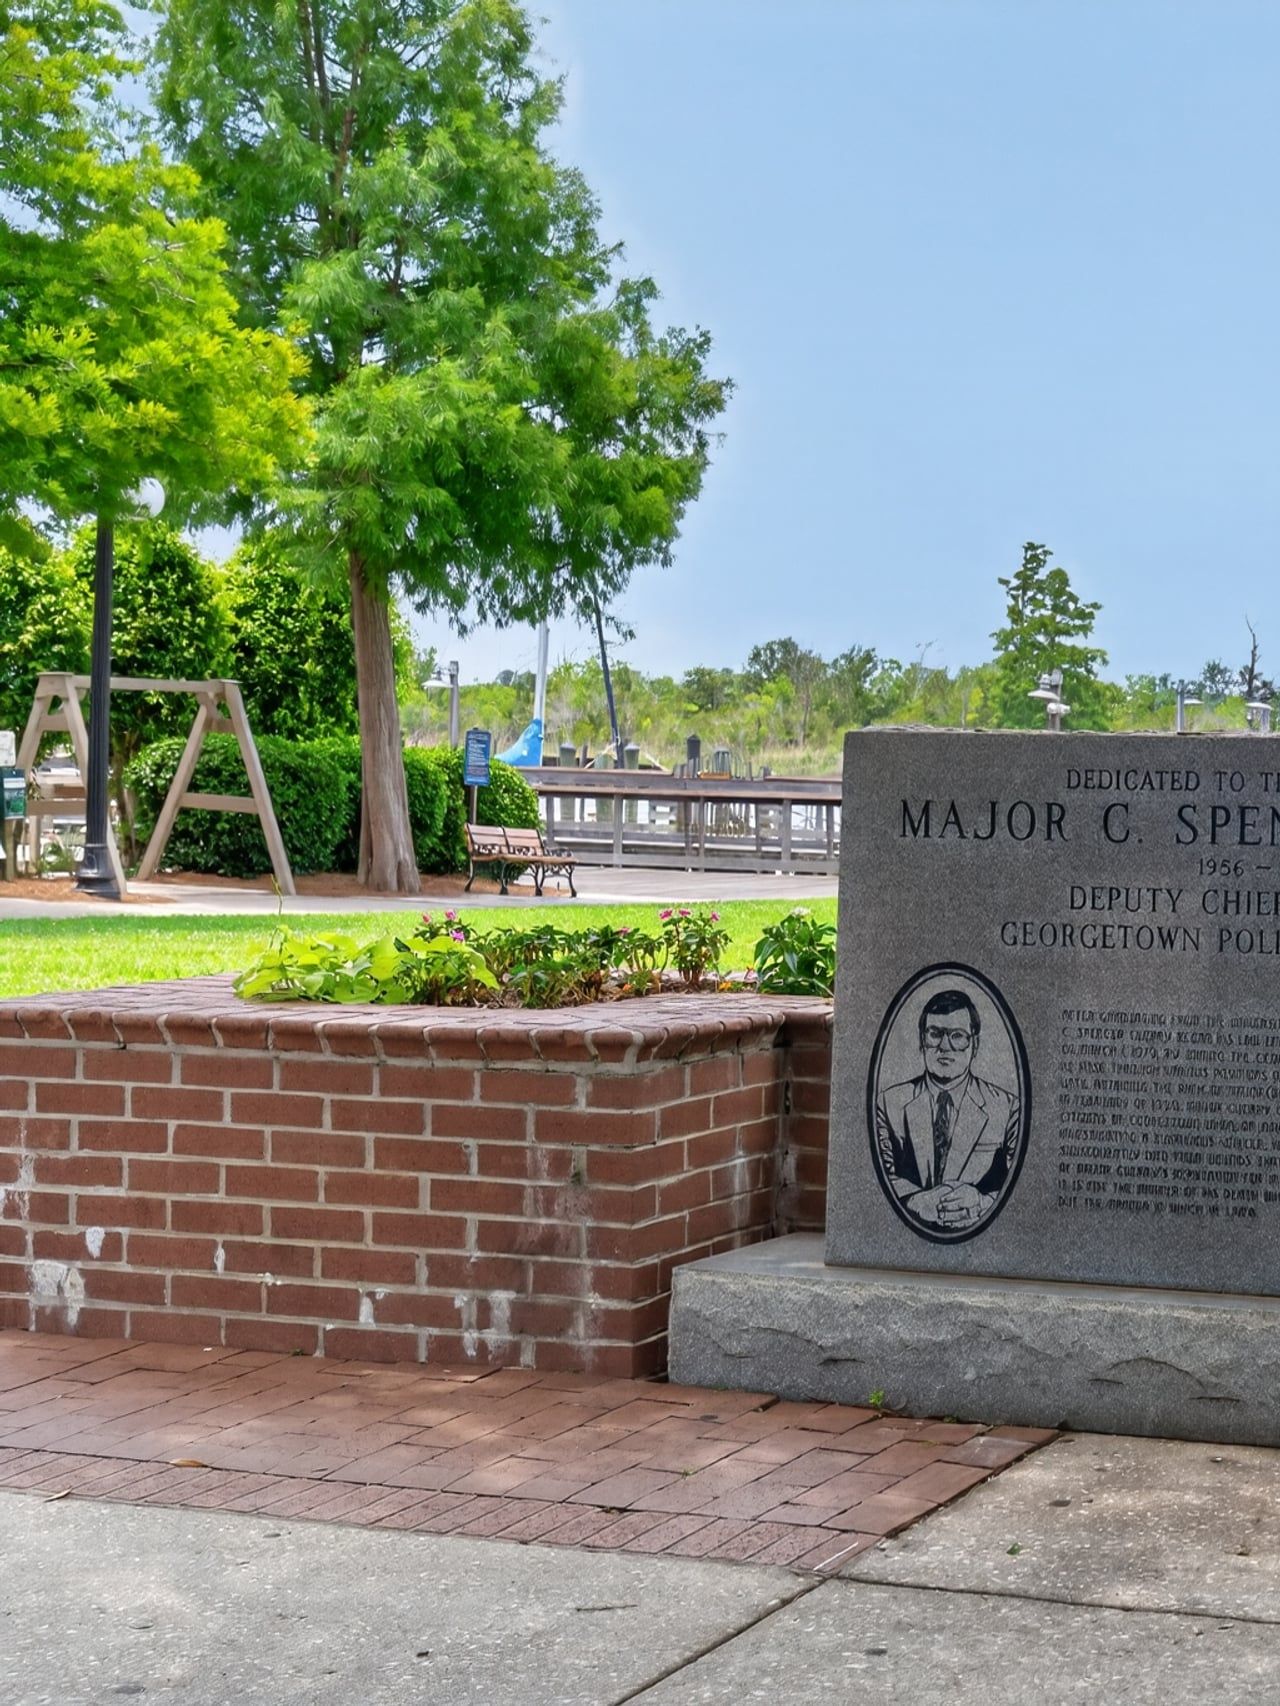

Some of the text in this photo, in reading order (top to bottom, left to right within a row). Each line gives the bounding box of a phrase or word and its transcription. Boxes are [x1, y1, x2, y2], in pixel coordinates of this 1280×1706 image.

[1066, 769, 1200, 793] DEDICATED
[1214, 771, 1245, 794] TO
[899, 800, 1067, 843] MAJOR
[1102, 803, 1144, 844] C.
[1199, 858, 1245, 878] 1956
[1069, 886, 1183, 914] DEPUTY
[1000, 922, 1200, 953] GEORGETOWN
